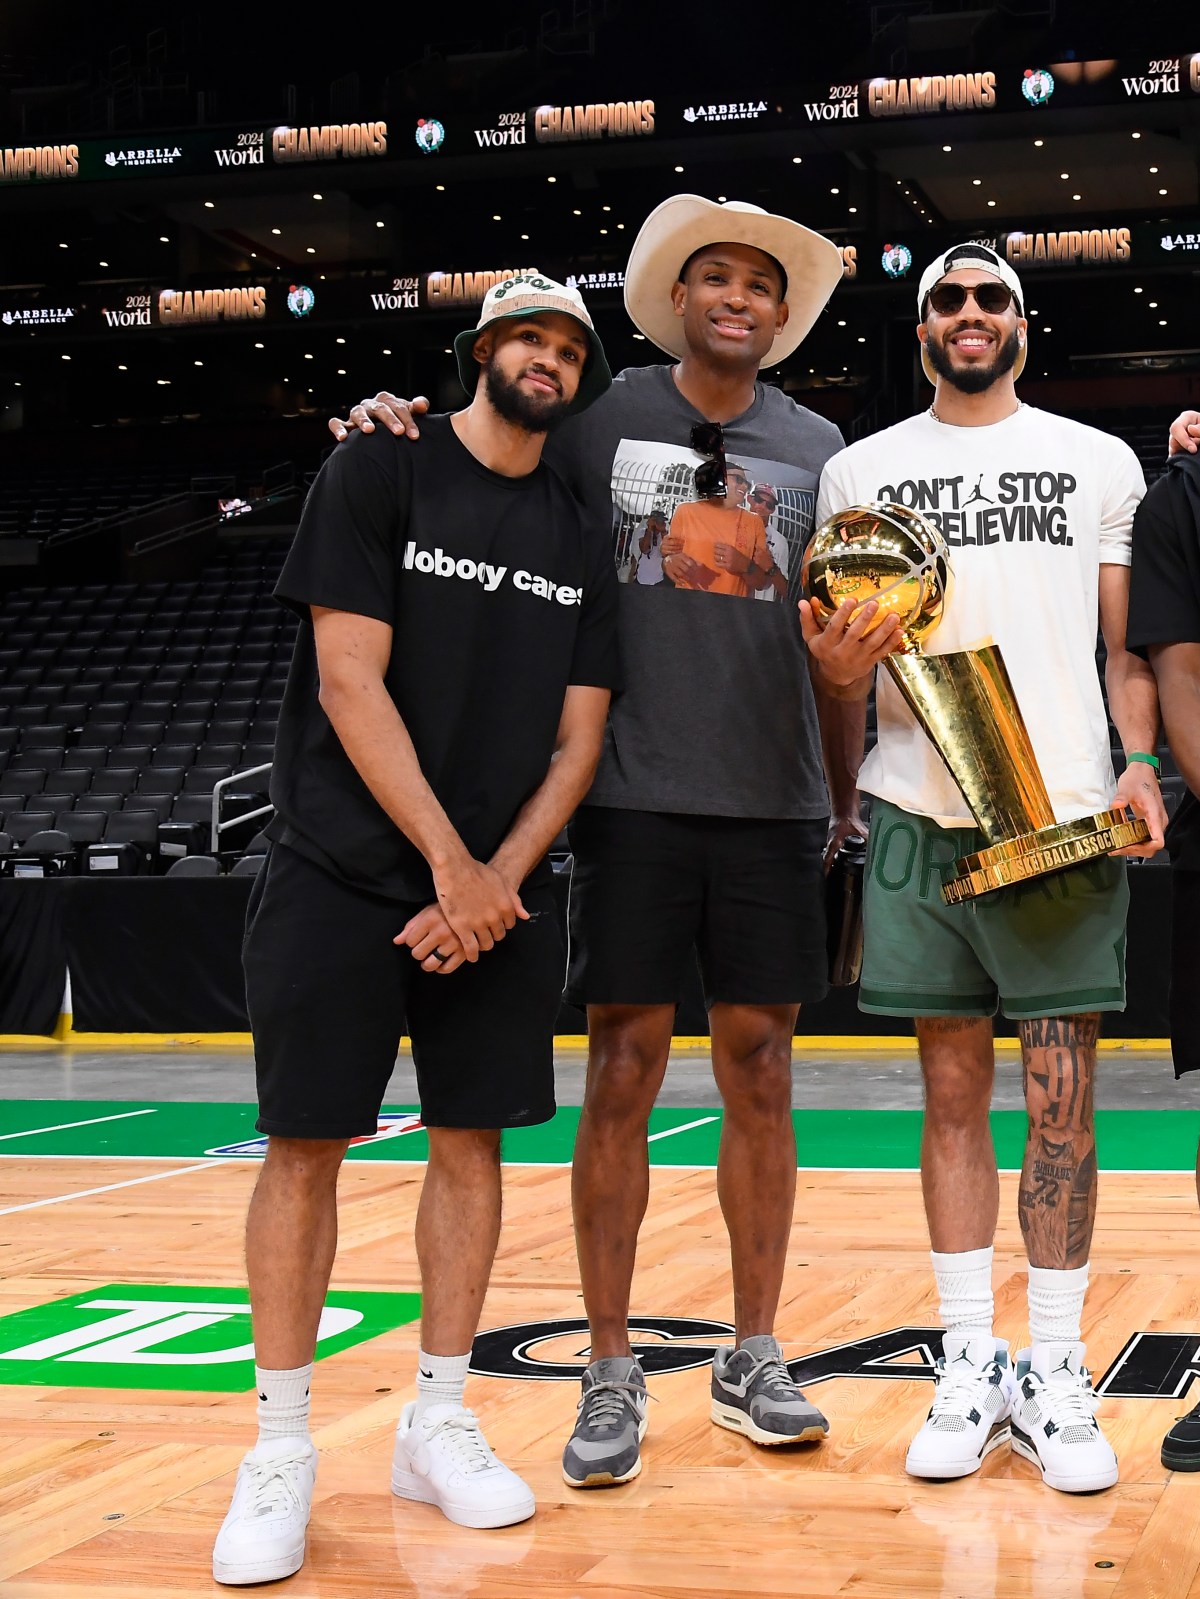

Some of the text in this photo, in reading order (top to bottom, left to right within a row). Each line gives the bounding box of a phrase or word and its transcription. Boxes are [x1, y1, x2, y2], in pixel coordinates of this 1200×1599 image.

[1149, 60, 1180, 74] 2024
[830, 85, 859, 99] 2024
[869, 71, 996, 118] CHAMPIONS
[1122, 73, 1180, 96] World
[696, 101, 764, 116] ARBELLA
[704, 111, 759, 121] INSURANCE
[804, 99, 859, 121] World
[498, 112, 526, 126] 2024
[535, 100, 655, 142] CHAMPIONS
[237, 133, 264, 146] 2024
[272, 122, 387, 162] CHAMPIONS
[474, 125, 526, 147] World
[117, 147, 180, 162] ARBELLA
[124, 156, 173, 166] INSURANCE
[215, 145, 264, 166] World
[1006, 228, 1131, 263] CHAMPIONS
[393, 278, 419, 291] 2024
[495, 275, 555, 299] BOSTON
[577, 271, 625, 284] ARBEL
[585, 279, 625, 289] INSURAN
[427, 268, 539, 308] CHAMPI
[126, 295, 151, 307] 2024
[159, 286, 266, 323] CHAMPIONS
[371, 290, 419, 310] World
[12, 307, 72, 320] ARBELLA
[20, 316, 66, 324] INSURANCE
[105, 307, 151, 327] World
[877, 471, 1077, 510] DON'T STOP
[1001, 849, 1075, 883] BASKETBALL
[1, 1300, 364, 1363] TD
